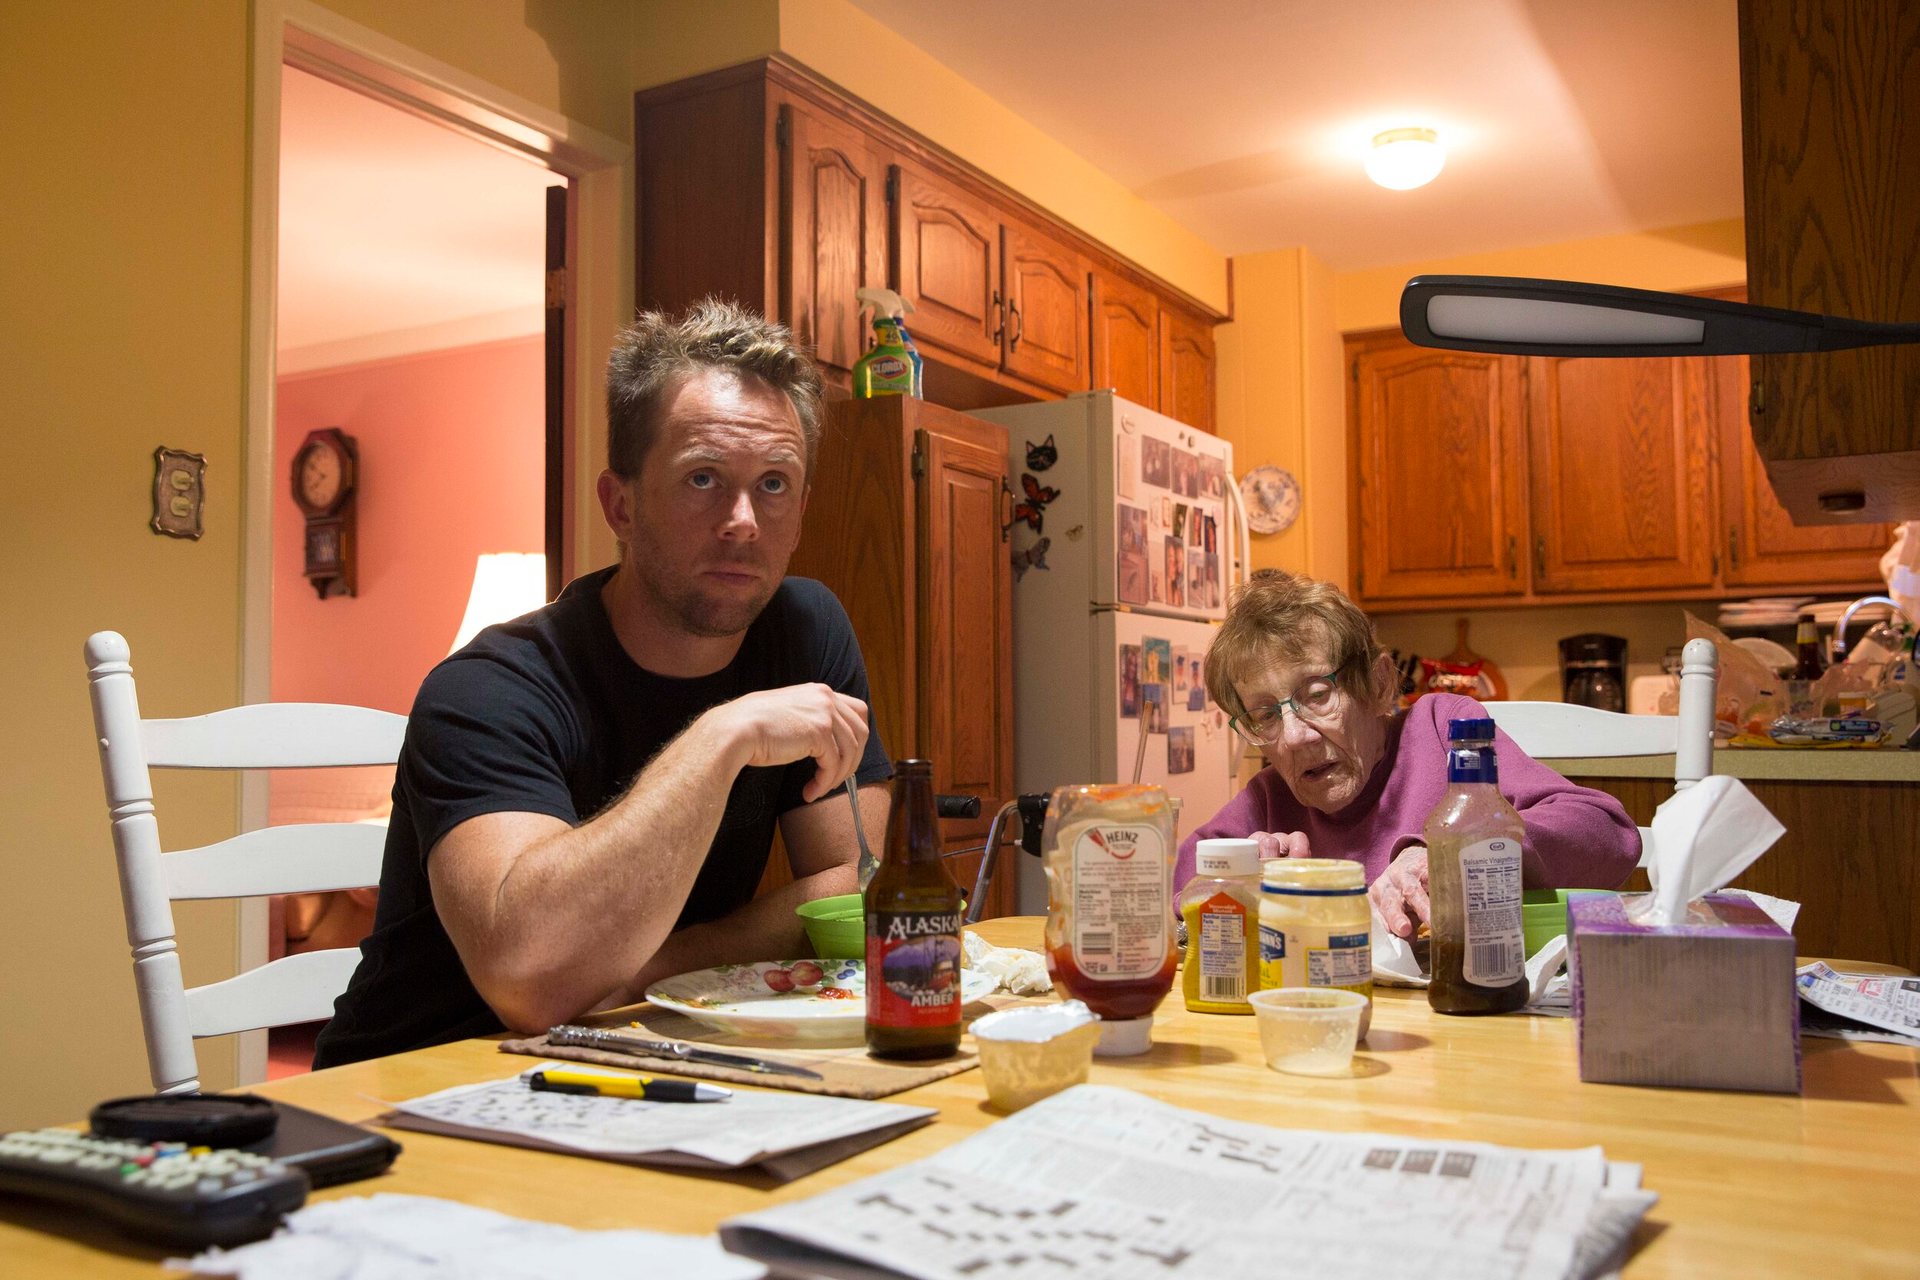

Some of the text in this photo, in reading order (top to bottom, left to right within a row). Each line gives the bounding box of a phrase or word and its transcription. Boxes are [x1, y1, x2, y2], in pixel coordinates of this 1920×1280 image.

[1106, 830, 1139, 845] HEINZ
[1463, 858, 1488, 866] Balsamic
[884, 913, 961, 945] ALASKA
[911, 994, 954, 1008] AMBER
